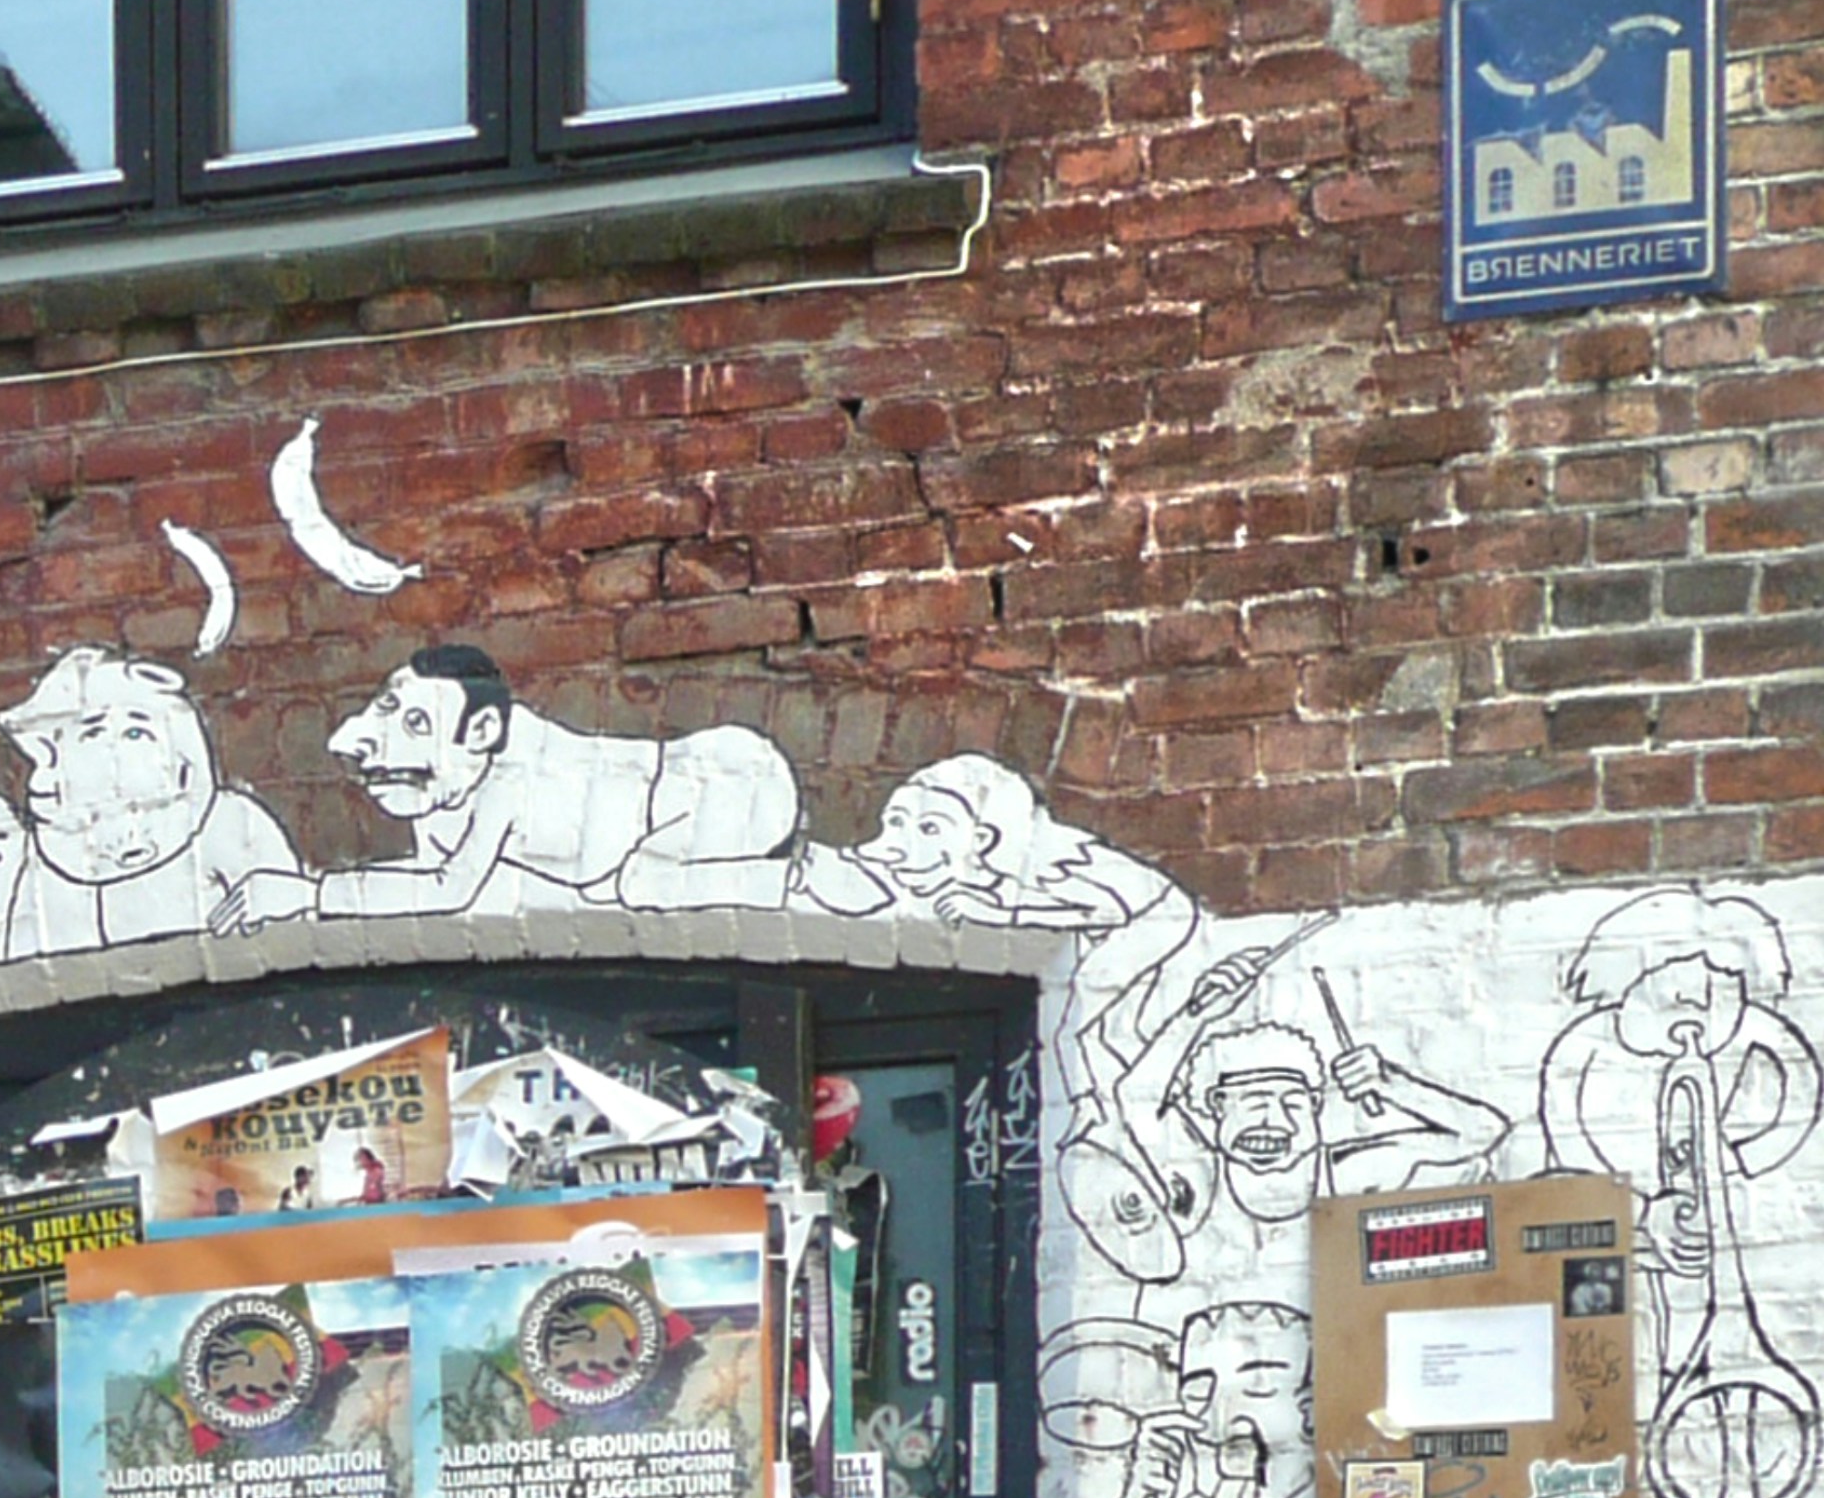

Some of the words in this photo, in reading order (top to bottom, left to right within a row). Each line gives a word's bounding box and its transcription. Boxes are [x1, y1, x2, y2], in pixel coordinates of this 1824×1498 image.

[1467, 235, 1703, 285] BRENNERIET
[32, 1206, 136, 1241] BREAKS
[439, 1439, 552, 1466] ALBOROSIE
[570, 1430, 730, 1458] GROUNDATION
[105, 1463, 214, 1489] ALBOROSIE
[232, 1452, 382, 1481] GROUNDATION
